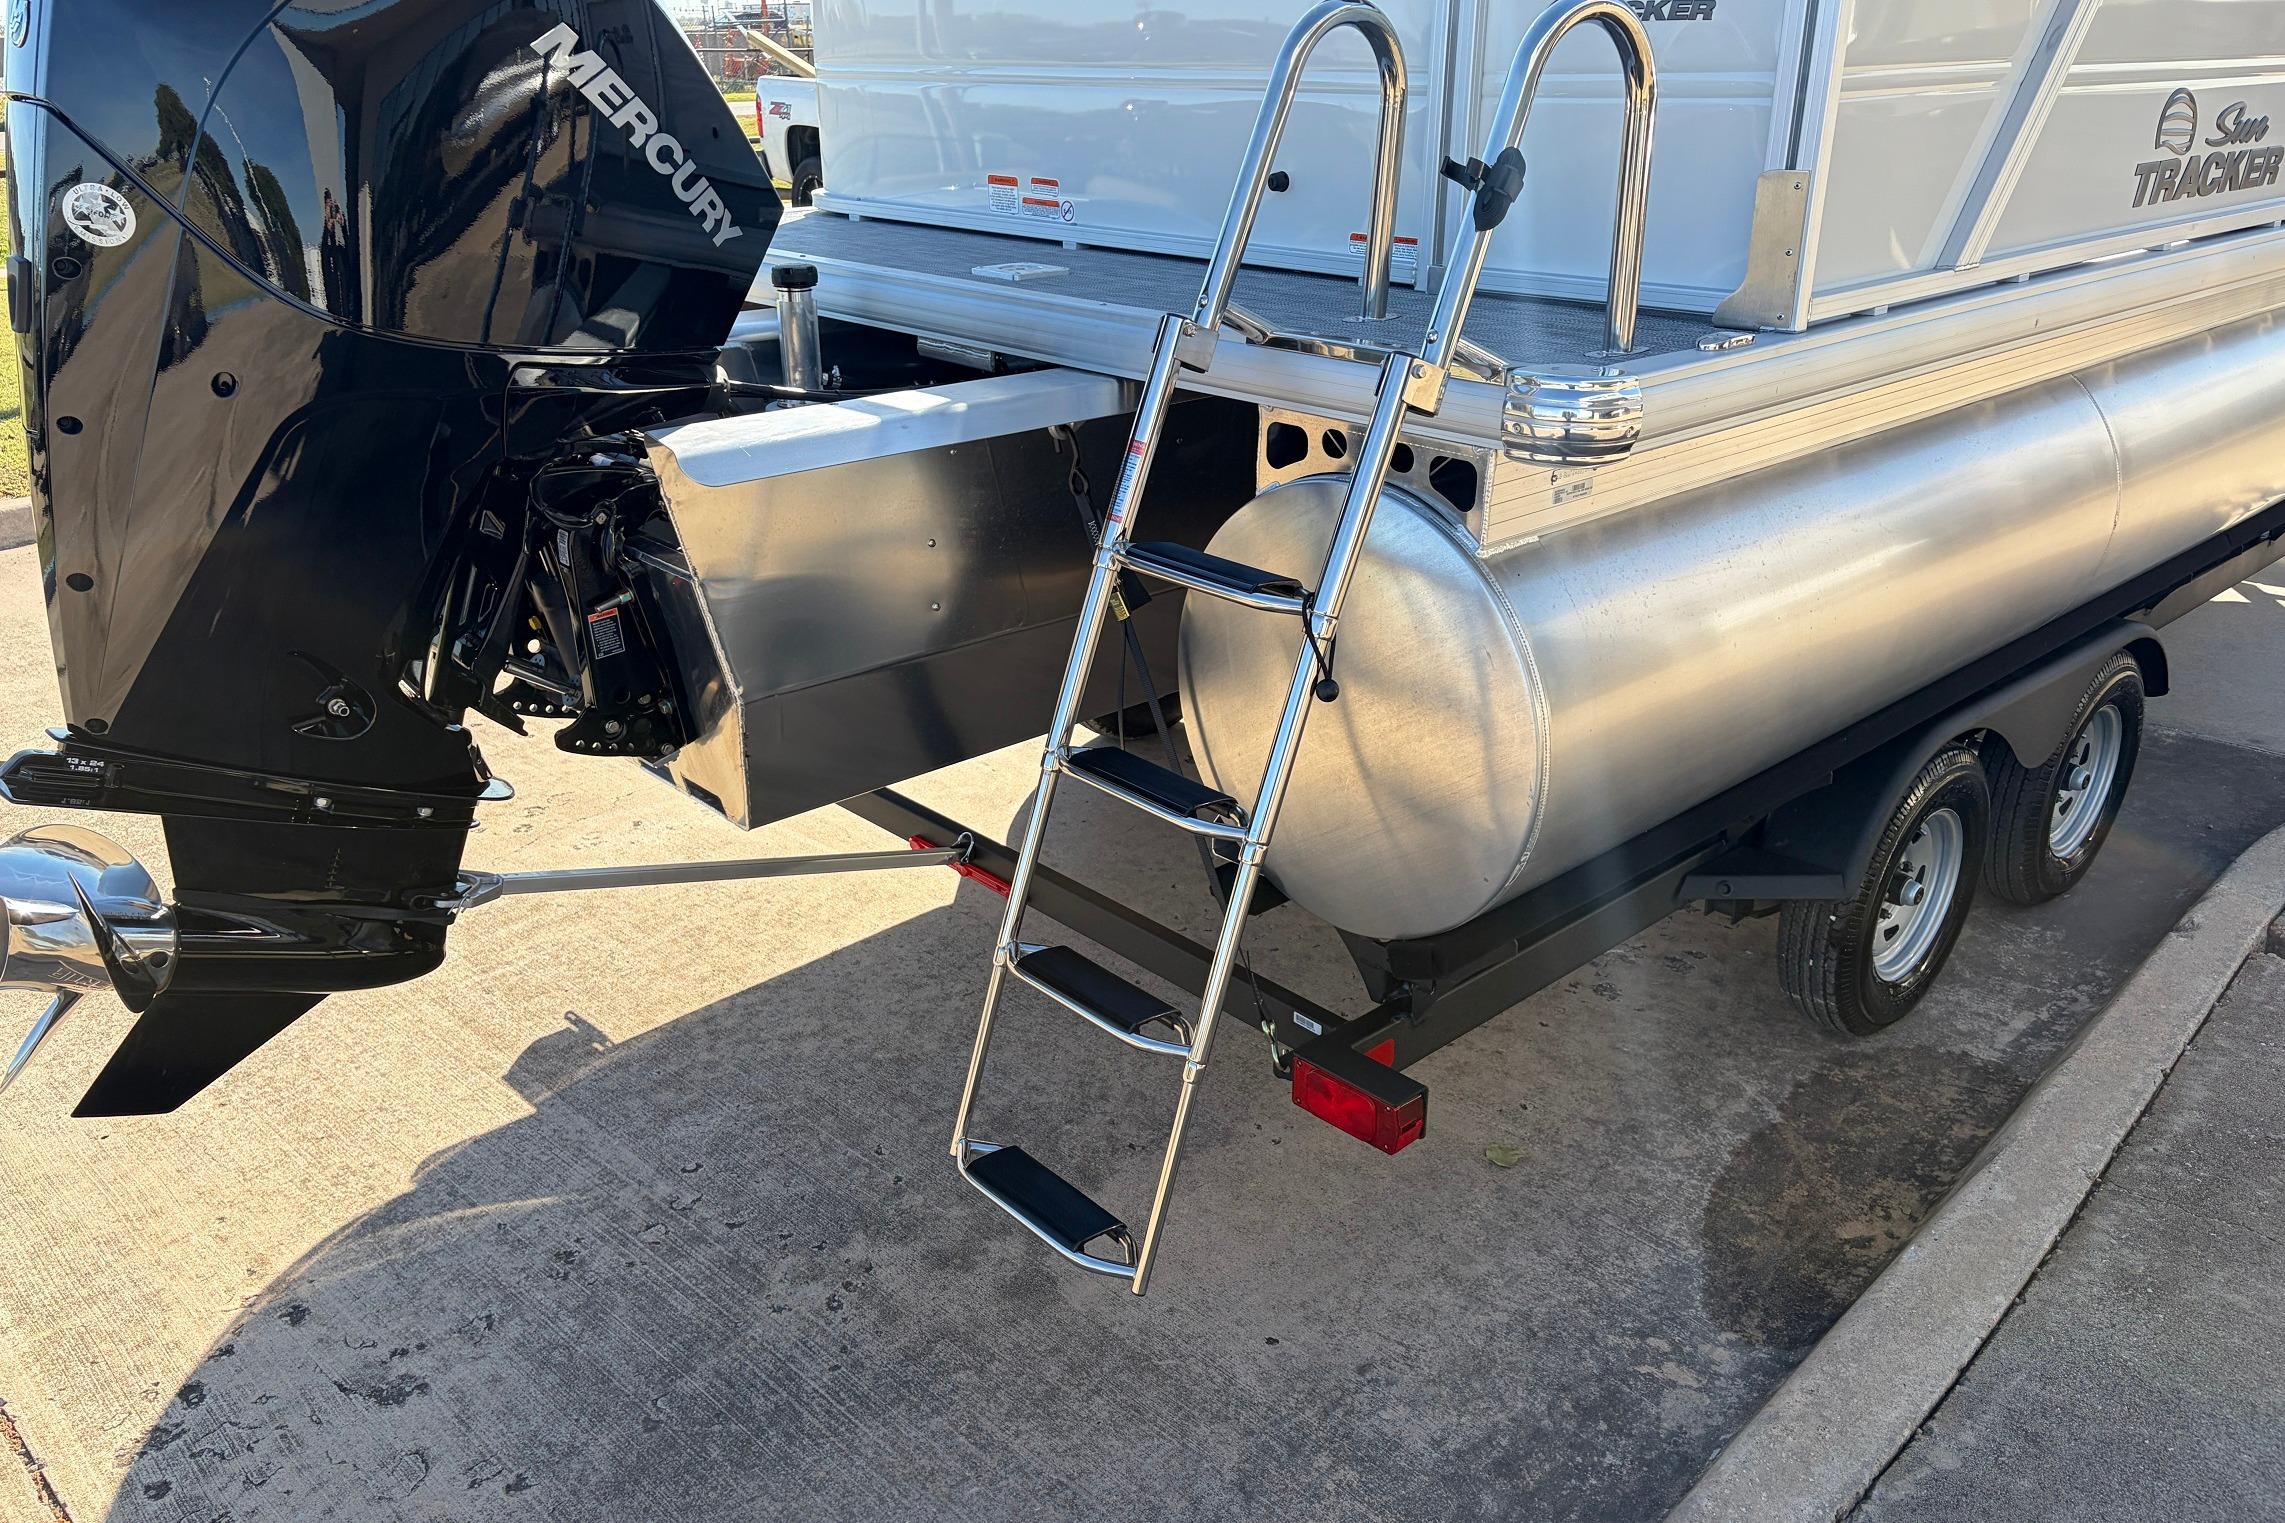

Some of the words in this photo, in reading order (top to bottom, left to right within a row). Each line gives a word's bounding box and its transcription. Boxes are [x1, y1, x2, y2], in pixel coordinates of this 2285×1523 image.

[1629, 0, 1717, 21] CKER
[529, 21, 744, 248] MERCURY
[2204, 100, 2270, 147] Sun
[2132, 145, 2284, 208] TRACKER
[66, 757, 80, 765] 13
